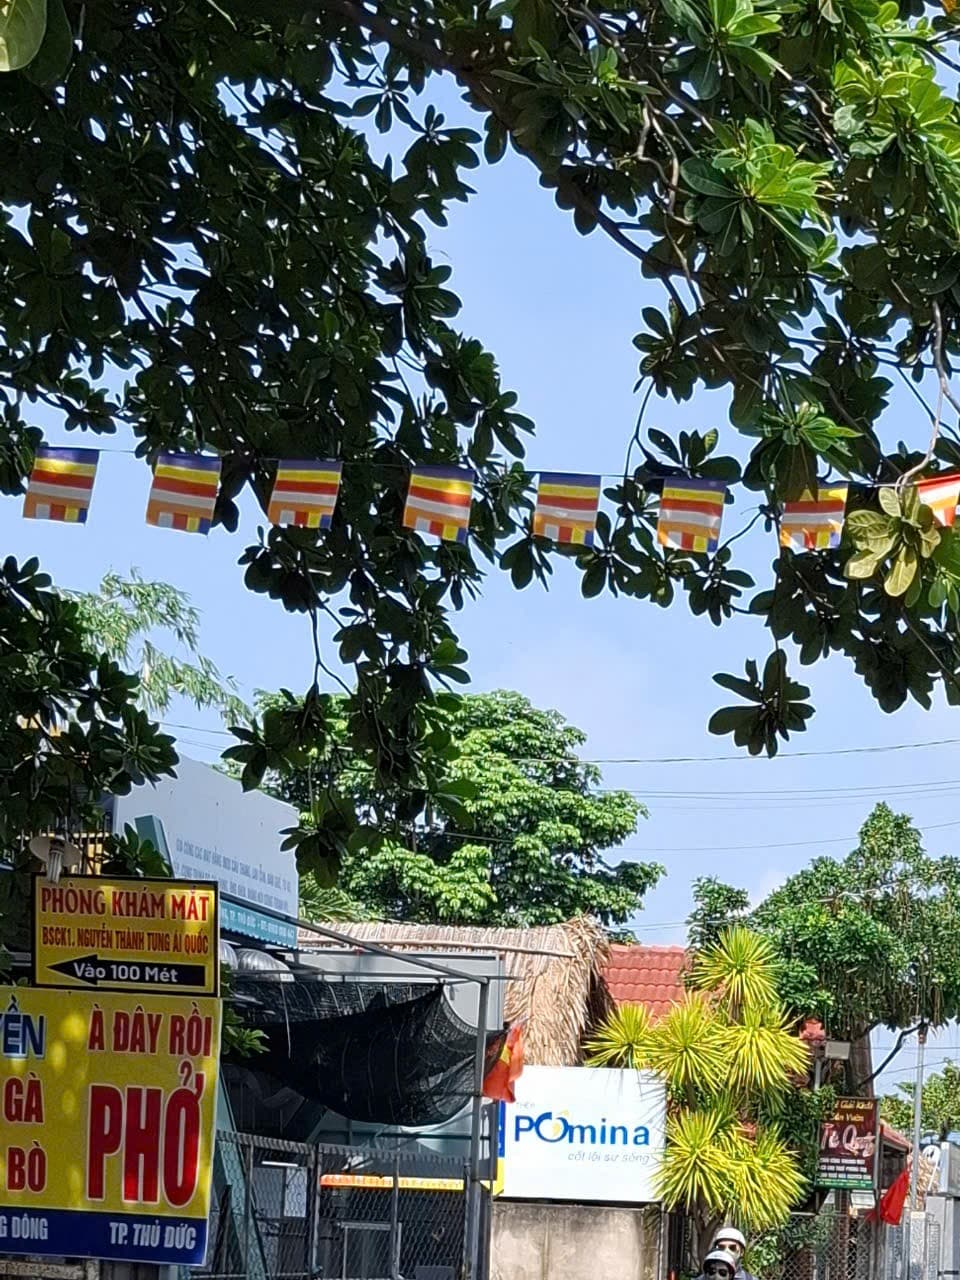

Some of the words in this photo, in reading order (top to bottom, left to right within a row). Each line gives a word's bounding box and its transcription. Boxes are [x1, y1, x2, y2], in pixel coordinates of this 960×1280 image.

[41, 882, 106, 916] PHÒNG
[112, 886, 166, 919] KHÁM
[171, 885, 209, 921] MẮT
[184, 928, 209, 955] QUỐC
[73, 962, 106, 978] Vào
[110, 964, 140, 980] 100
[145, 965, 178, 983] Mét
[0, 994, 45, 1057] ỀN
[88, 1003, 104, 1050] À
[113, 1004, 162, 1053] ĐÂY
[169, 1001, 213, 1057] RỒI
[4, 1072, 44, 1123] GÀ
[88, 1060, 206, 1207] PHỞ
[7, 1140, 46, 1192] BÒ
[109, 1222, 128, 1245] TP.
[133, 1219, 161, 1248] THỦ
[164, 1223, 196, 1250] ĐỨC
